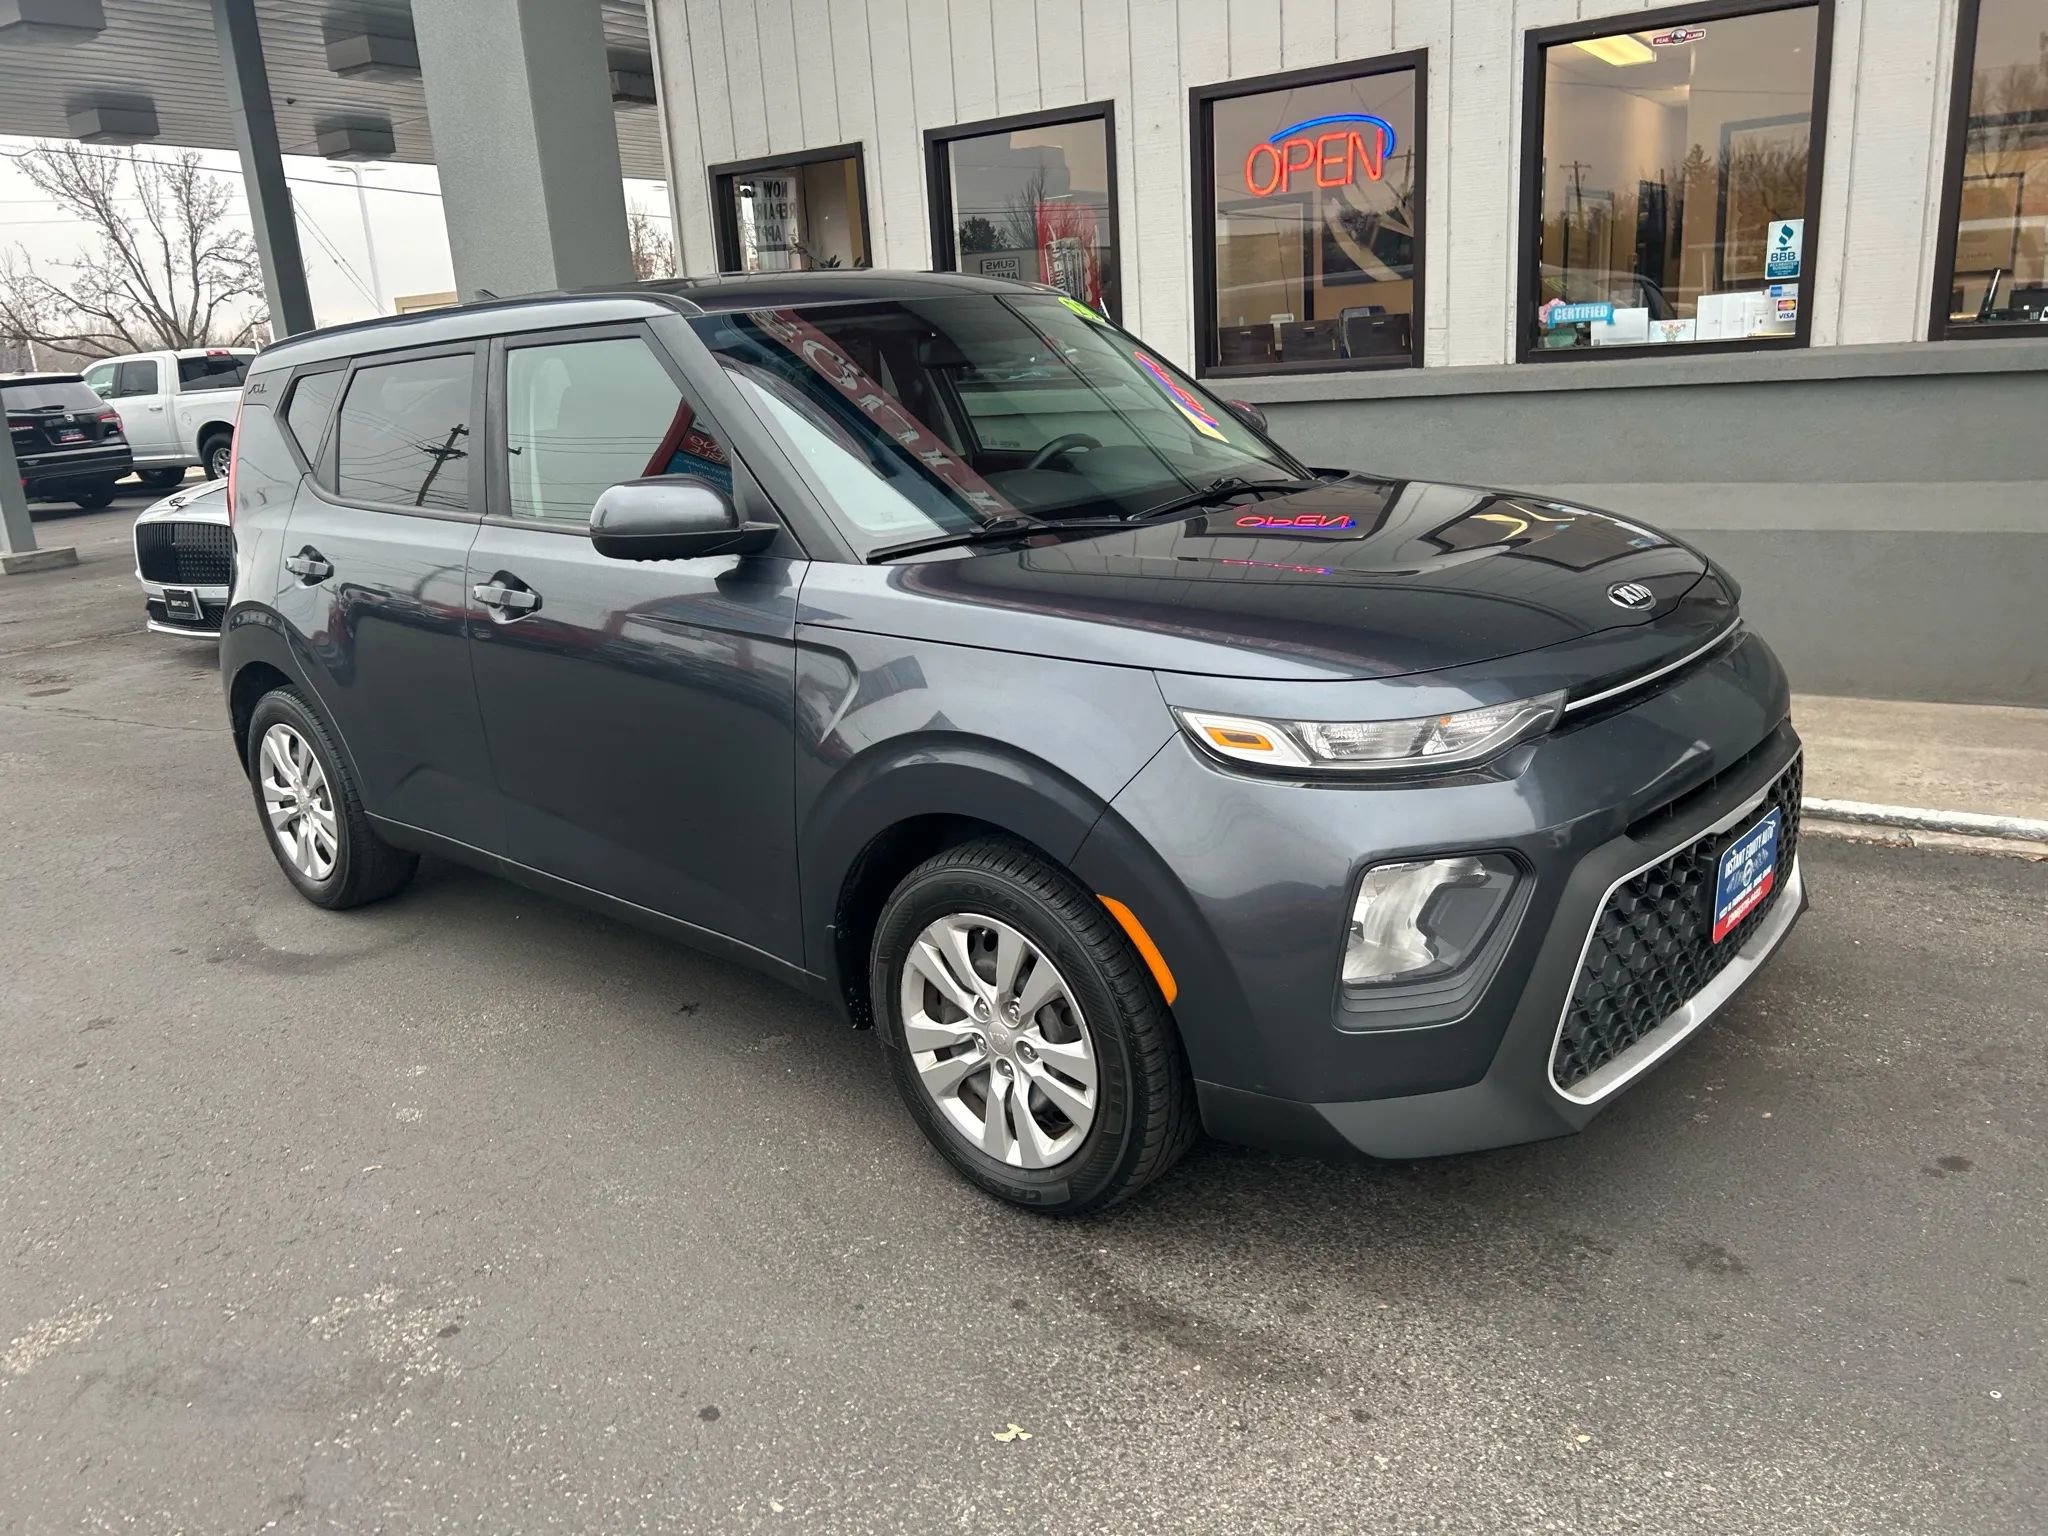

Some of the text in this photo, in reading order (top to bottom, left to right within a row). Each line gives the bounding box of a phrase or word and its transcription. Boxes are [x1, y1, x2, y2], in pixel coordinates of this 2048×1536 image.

[1244, 127, 1385, 198] OPEN
[1770, 251, 1796, 262] BBB
[1554, 305, 1608, 320] CERTIFIED
[1613, 583, 1651, 605] KIA
[1725, 848, 1746, 879] INSTANT
